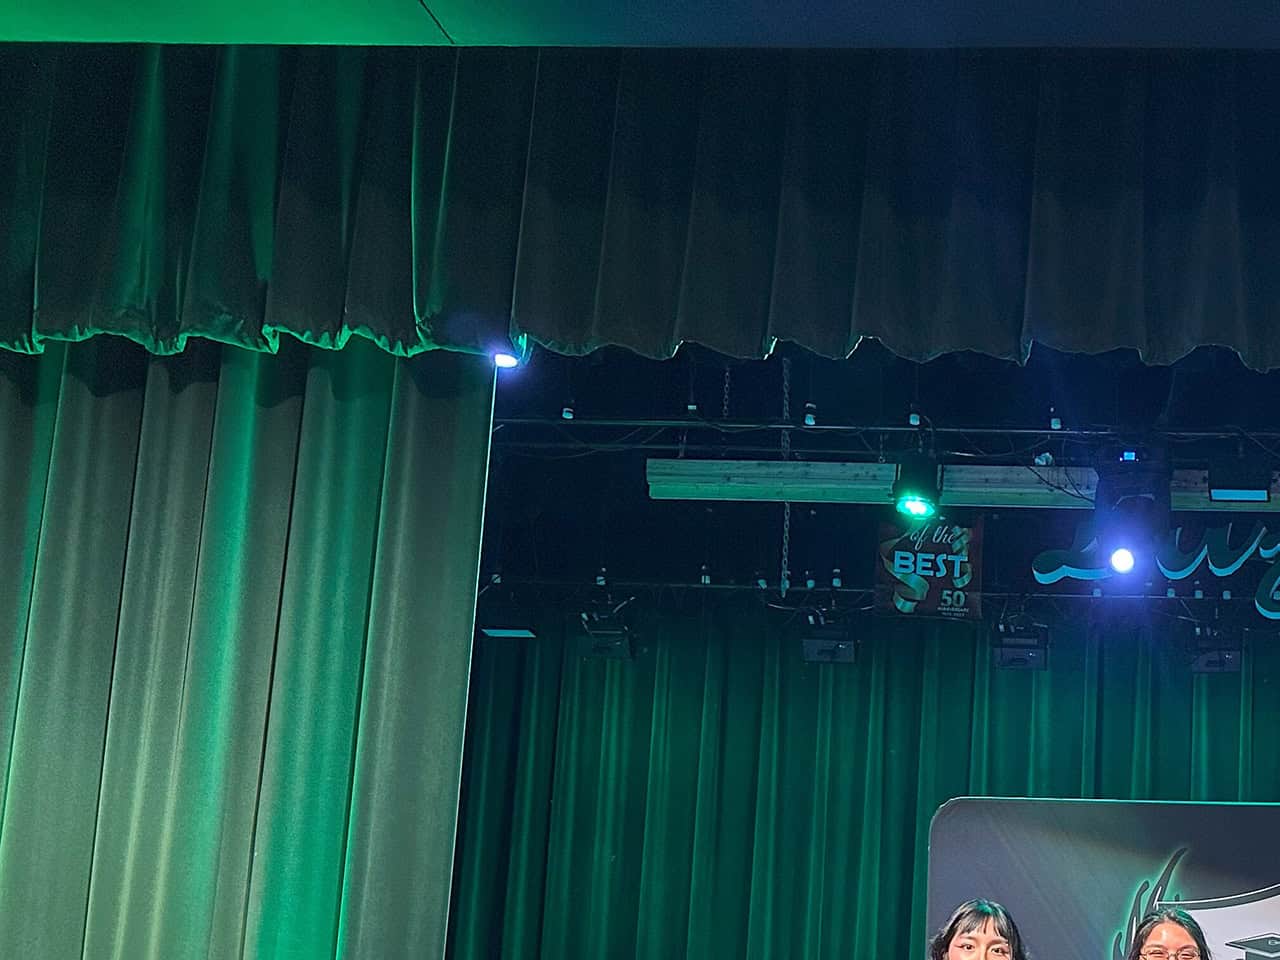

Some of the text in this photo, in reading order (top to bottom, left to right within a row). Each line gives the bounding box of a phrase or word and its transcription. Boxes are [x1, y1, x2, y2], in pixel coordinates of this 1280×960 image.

[910, 524, 954, 551] of the
[894, 550, 969, 578] BEST
